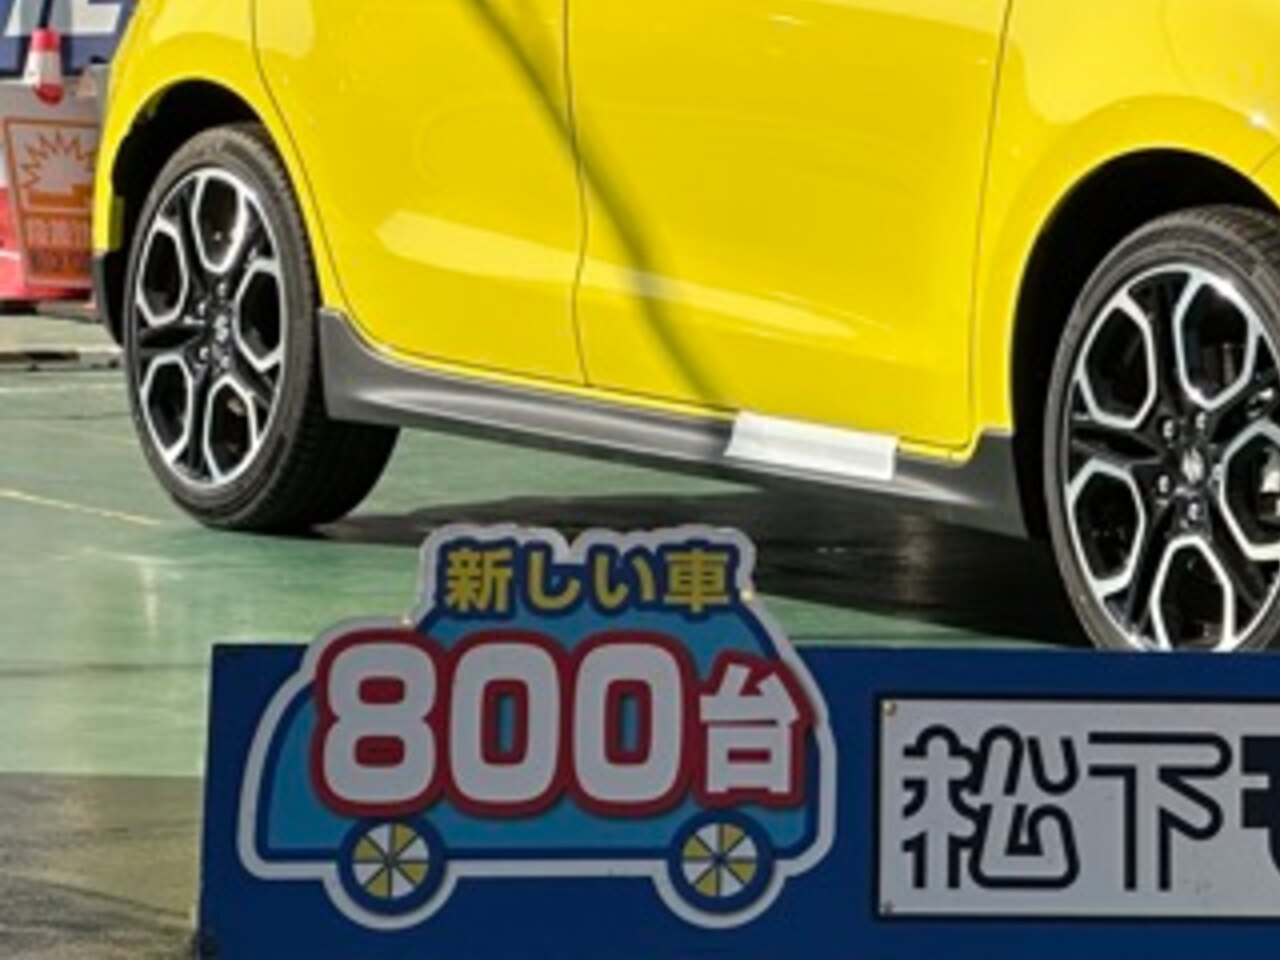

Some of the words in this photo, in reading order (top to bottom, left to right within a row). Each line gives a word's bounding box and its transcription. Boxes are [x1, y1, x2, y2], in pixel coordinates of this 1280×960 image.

[446, 547, 733, 613] 新しい車
[323, 642, 800, 805] 800台
